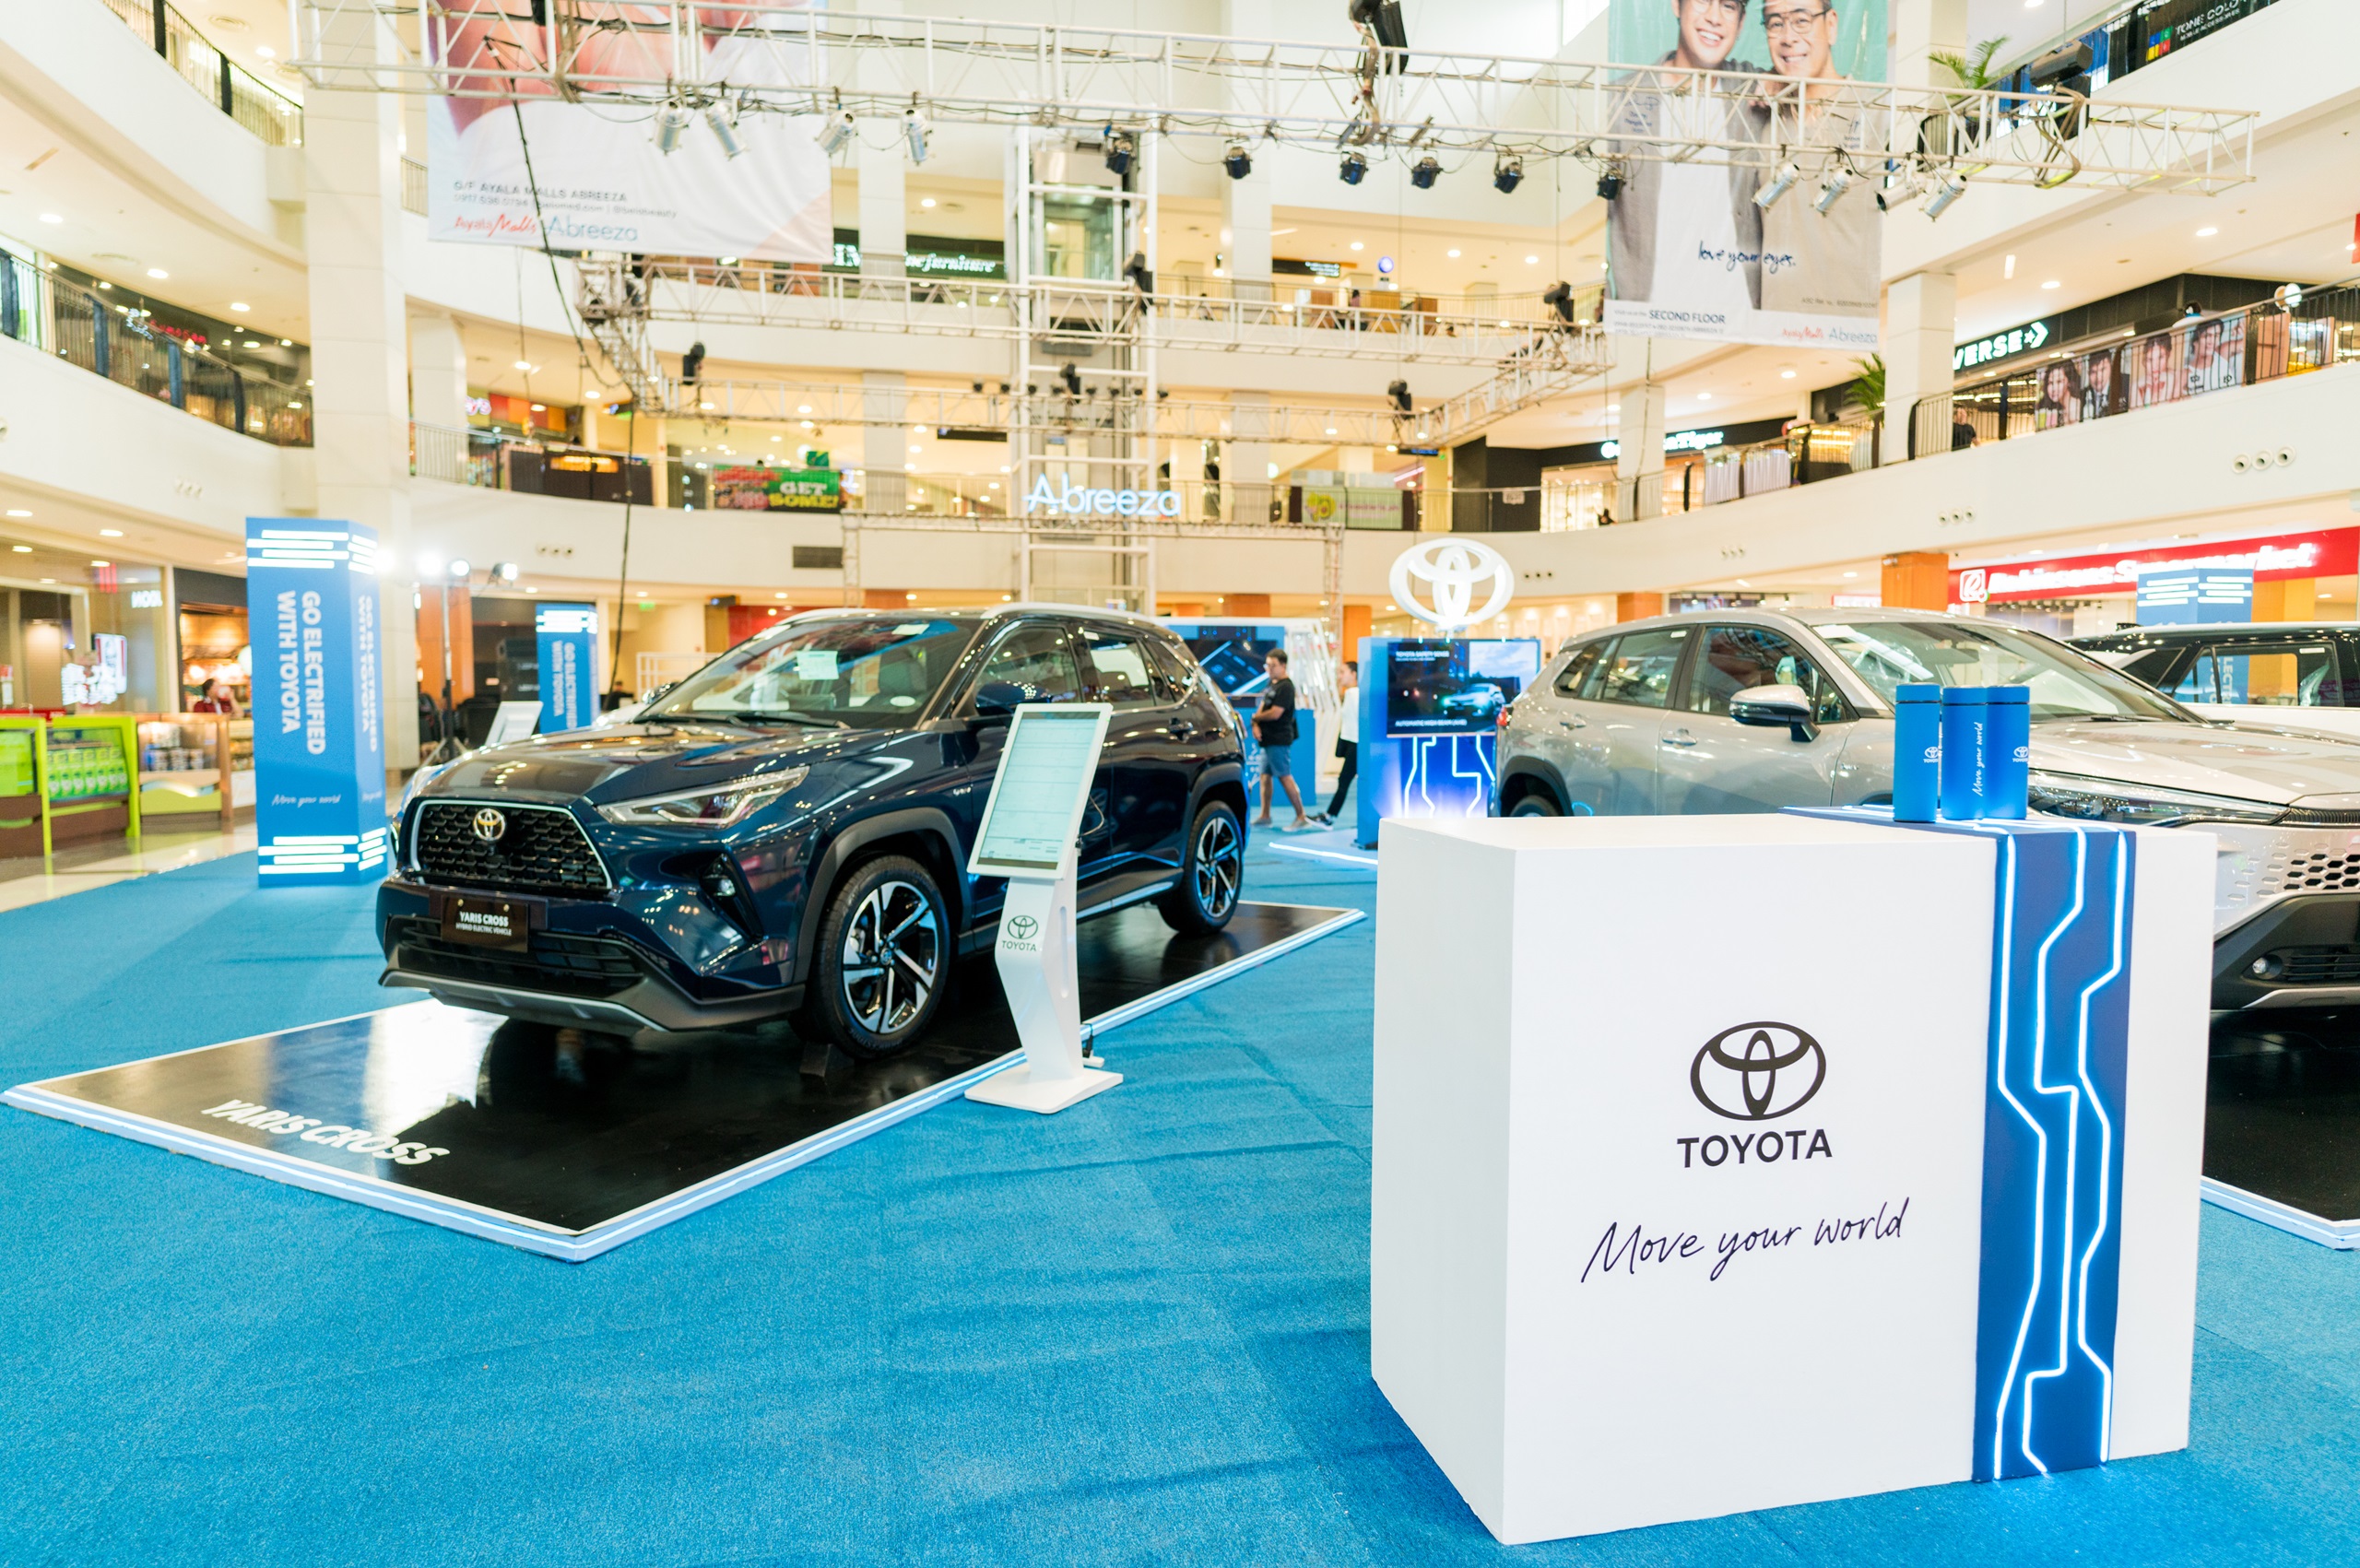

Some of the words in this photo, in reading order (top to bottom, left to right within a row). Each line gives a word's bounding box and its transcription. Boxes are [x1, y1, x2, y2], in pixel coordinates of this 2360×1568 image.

[2176, 14, 2205, 35] TONE
[2207, 0, 2247, 20] COLO
[479, 183, 520, 195] AYALA
[525, 185, 566, 198] MALLS
[571, 189, 628, 202] ABREEZA
[542, 214, 639, 242] Abreeza
[1698, 240, 1725, 261] love
[1726, 251, 1760, 272] your
[1648, 310, 1690, 322] SECOND
[1692, 312, 1726, 324] FLOOR
[1828, 327, 1878, 344] Abreeza
[779, 480, 827, 496] GET
[1021, 472, 1182, 516] Abreeza
[277, 590, 298, 648] WITH
[301, 591, 322, 625] GO
[279, 651, 301, 734] TOYOTA
[302, 628, 326, 755] ELECTRIFIED
[1974, 721, 1984, 746] world
[1976, 747, 1986, 769] your
[1972, 769, 1984, 796] Move
[455, 922, 473, 931] HYBRID
[473, 924, 493, 934] ELECTRIC
[493, 926, 512, 937] VEHICLE
[459, 911, 482, 924] YARIS
[482, 914, 509, 927] CROSS
[1002, 940, 1037, 951] TOYOTA
[200, 1099, 322, 1134] YARIS
[300, 1125, 451, 1166] CROSS
[1676, 1128, 1834, 1169] TOYOTA
[1580, 1220, 1705, 1283] Move
[1709, 1226, 1803, 1282] your
[1813, 1196, 1910, 1246] world
